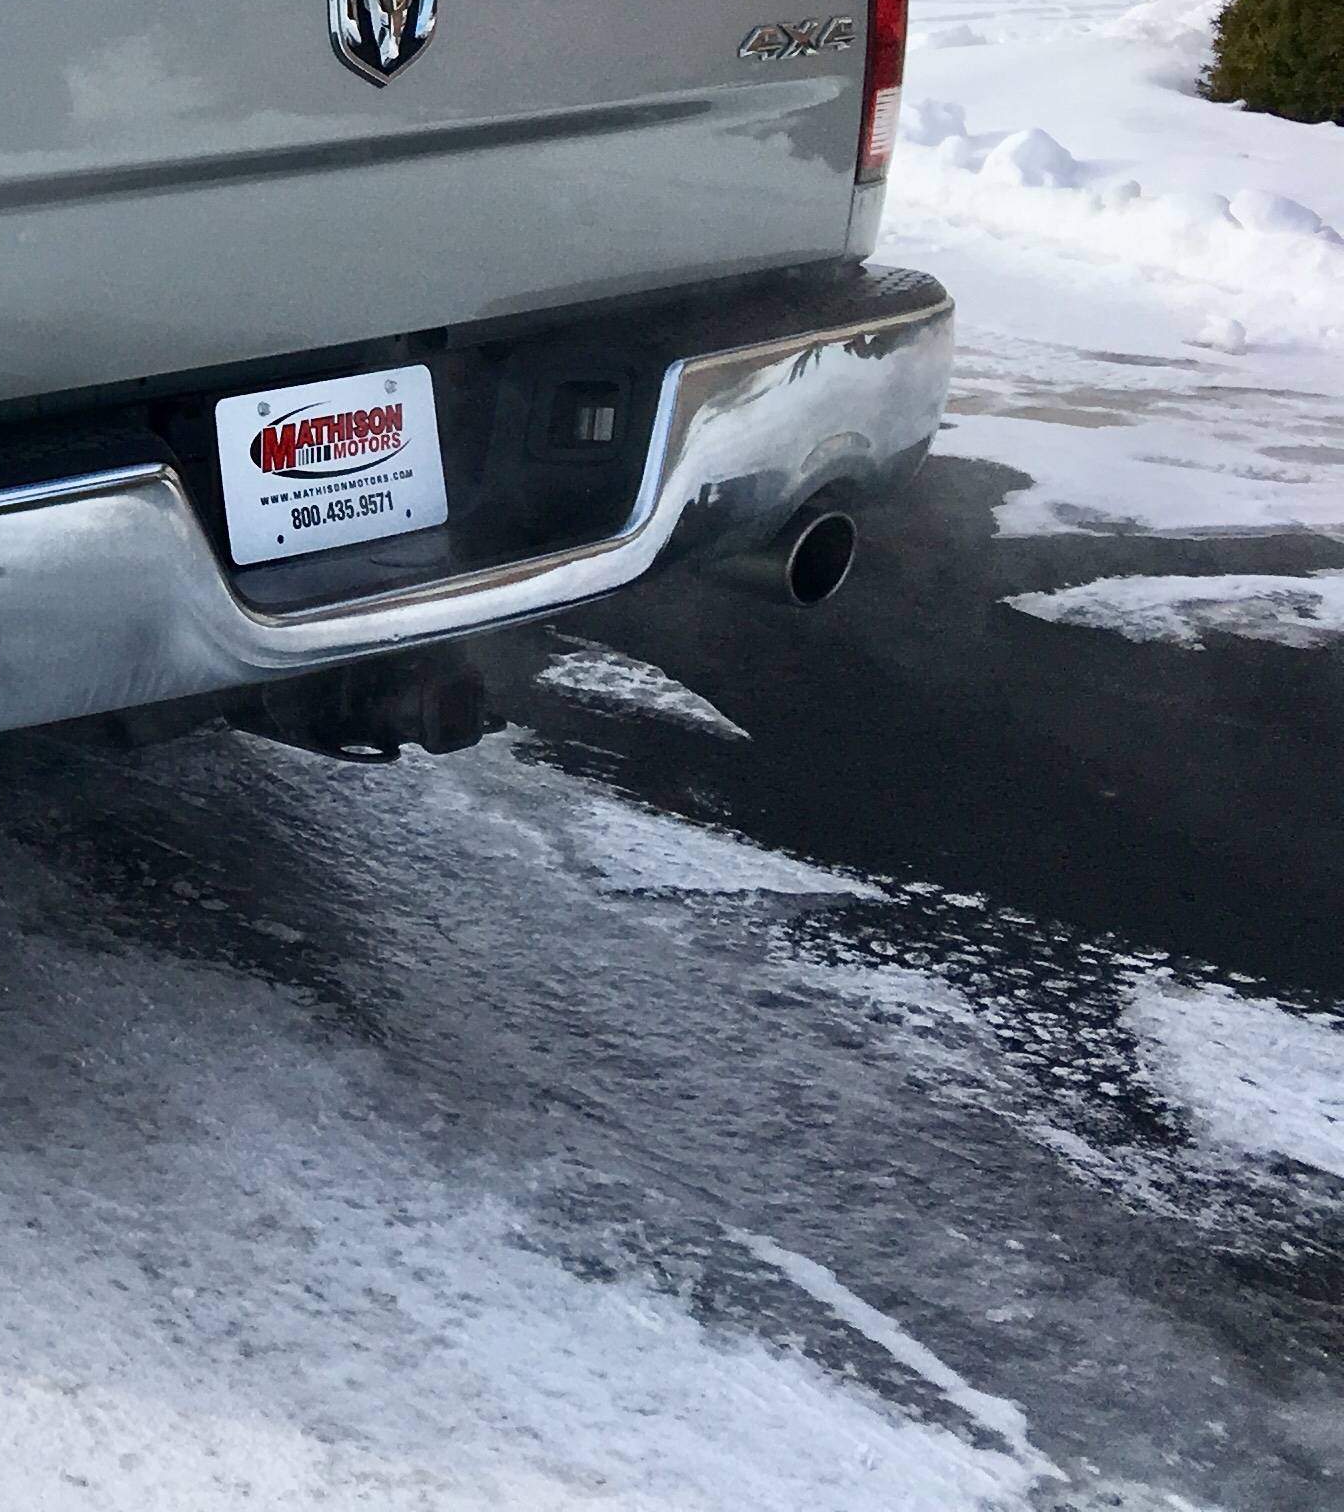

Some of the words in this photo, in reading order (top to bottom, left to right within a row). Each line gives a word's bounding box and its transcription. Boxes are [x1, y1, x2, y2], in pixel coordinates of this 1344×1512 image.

[261, 403, 403, 473] MATHISON
[333, 432, 402, 460] MOTORS
[260, 469, 414, 506] WWW.MATHISONMOTORS.COM
[291, 490, 394, 530] 800.435.9571
